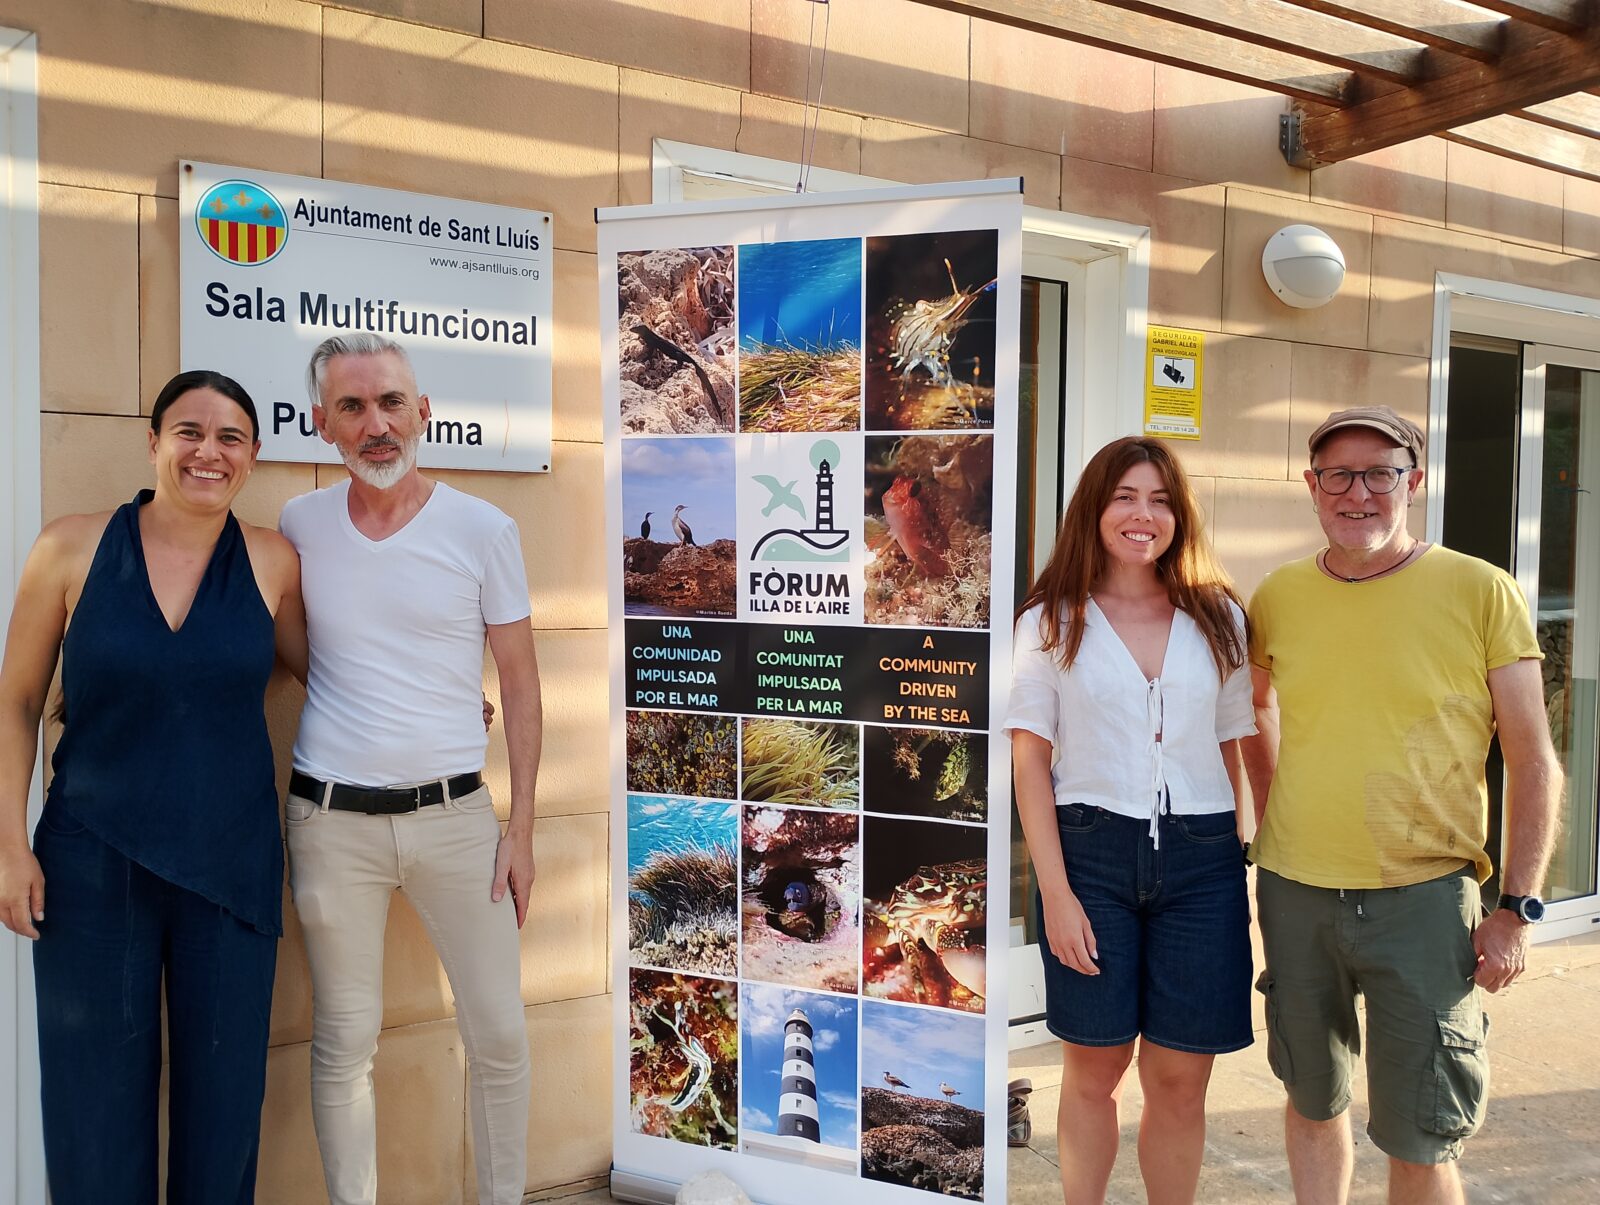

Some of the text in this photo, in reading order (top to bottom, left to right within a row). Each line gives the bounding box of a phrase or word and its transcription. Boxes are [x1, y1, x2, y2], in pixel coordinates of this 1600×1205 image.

[293, 198, 540, 251] Ajuntament de Sant Lluís
[429, 255, 540, 281] www.ajsantlluis.org
[205, 281, 538, 346] Sala Multifuncional
[1152, 331, 1198, 342] SEGURIDAD
[1152, 337, 1178, 347] GABRIEL
[426, 412, 483, 446] ima
[749, 566, 850, 598] FÒRUM
[749, 600, 780, 614] ILLA
[782, 601, 802, 614] DE
[662, 625, 692, 640] UNA
[783, 629, 816, 644] UNA
[922, 635, 934, 649] A
[632, 646, 722, 663] COMUNIDAD
[756, 651, 844, 669] COMUNITAT
[878, 657, 977, 677] COMMUNITY
[636, 668, 717, 685] IMPULSADA
[757, 674, 843, 692] IMPULSADA
[635, 690, 719, 708] POR EL MAR
[899, 682, 957, 699] DRIVEN
[756, 697, 843, 715] PER LA MAR
[884, 705, 971, 725] BY THE SEA
